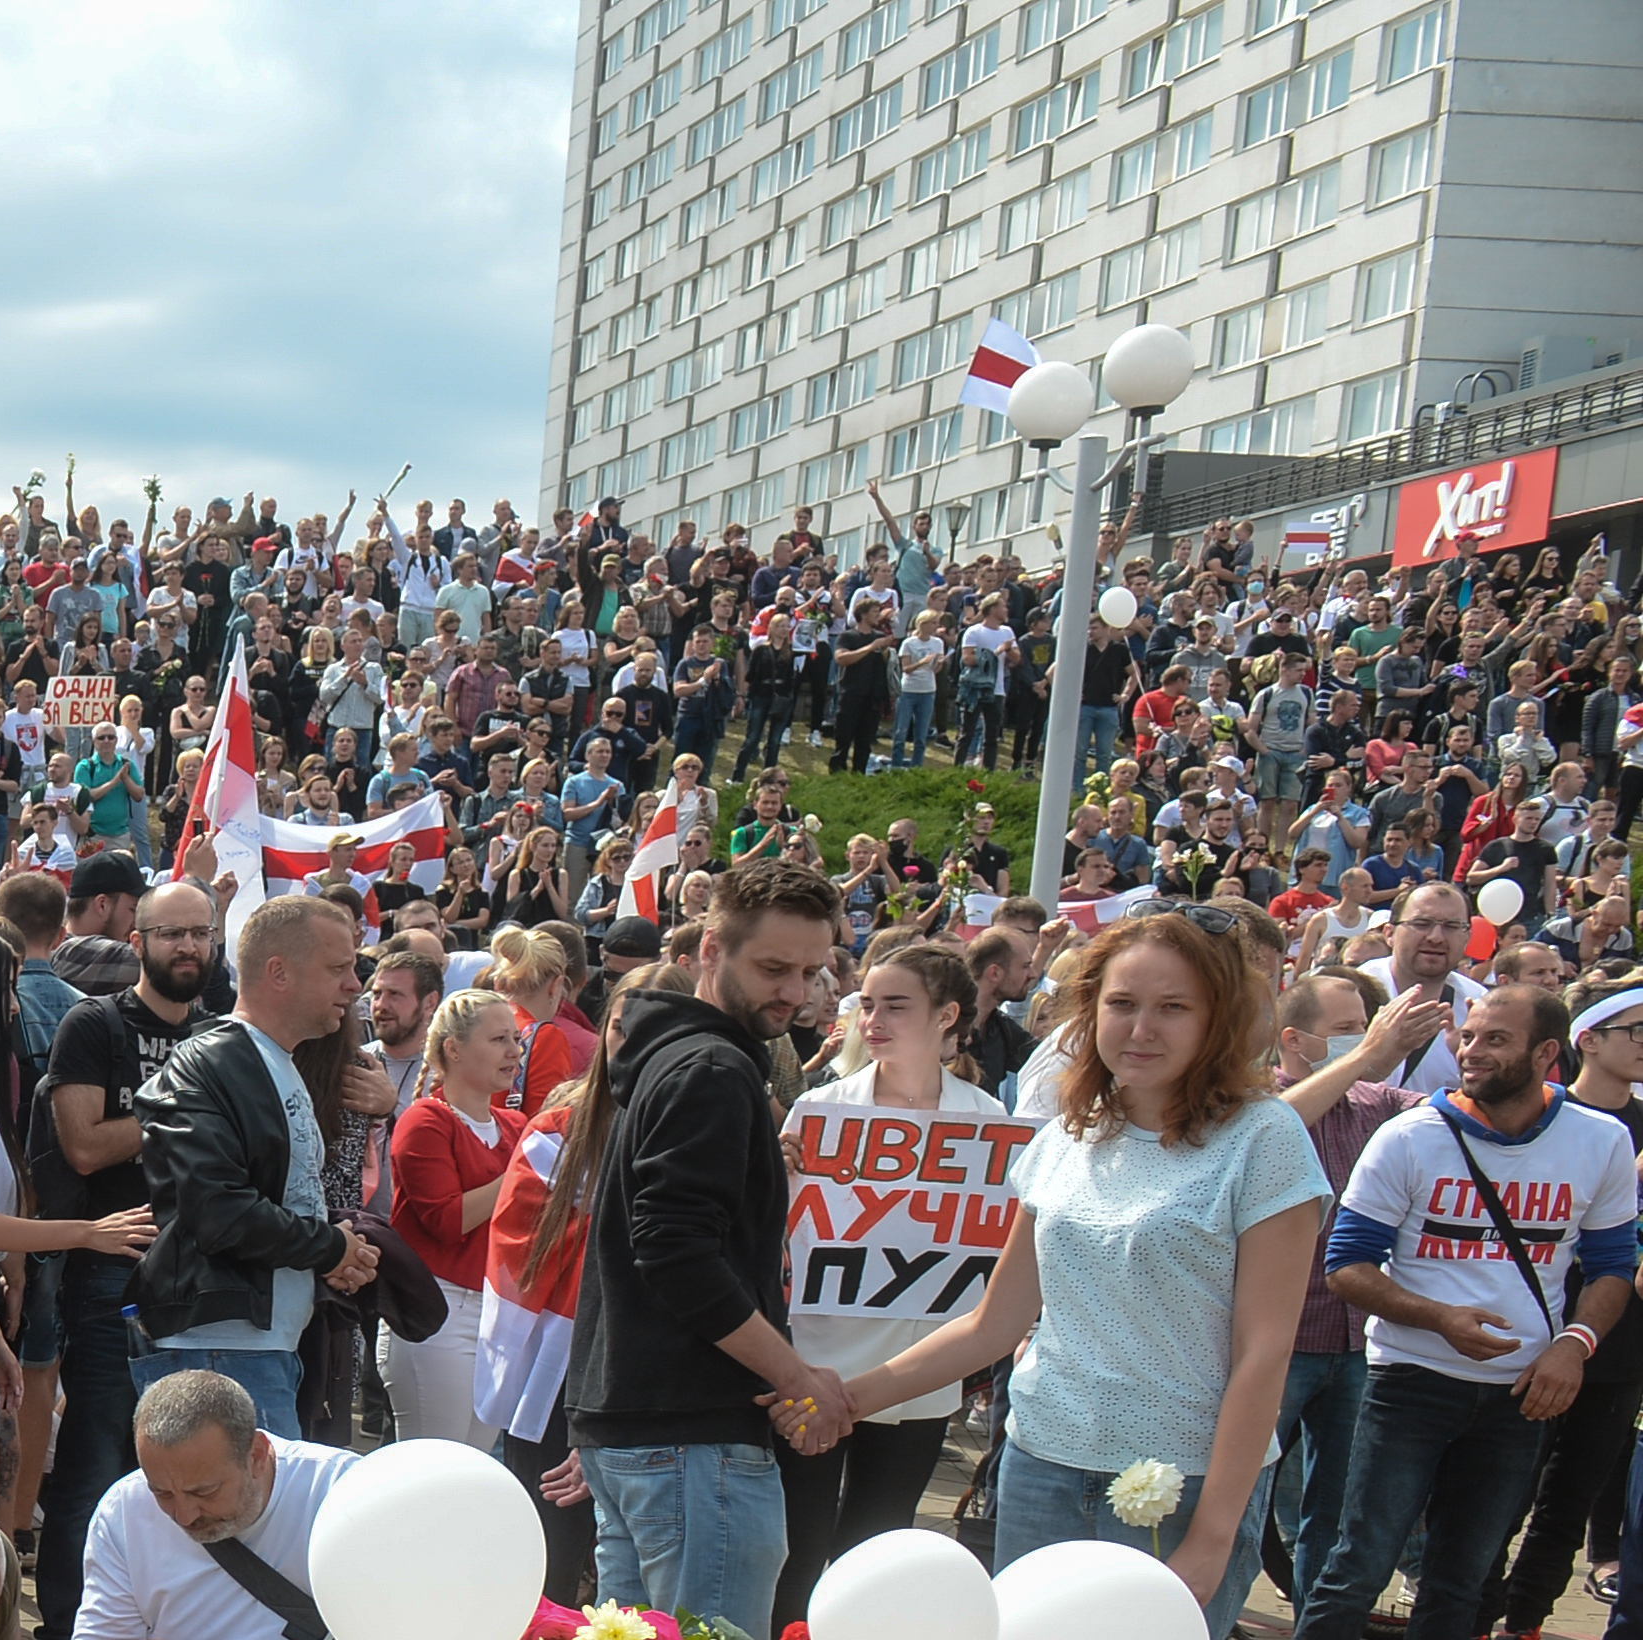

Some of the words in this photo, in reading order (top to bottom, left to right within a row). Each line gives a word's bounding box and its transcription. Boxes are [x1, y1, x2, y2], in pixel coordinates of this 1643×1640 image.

[42, 700, 61, 725] ЗА
[69, 700, 114, 725] ВСЕХ
[53, 677, 113, 699] ОДИН
[798, 1115, 1036, 1186] ЦВЕТ
[788, 1184, 1020, 1249] ЛУЧШ
[802, 1247, 1001, 1315] ПУЛ
